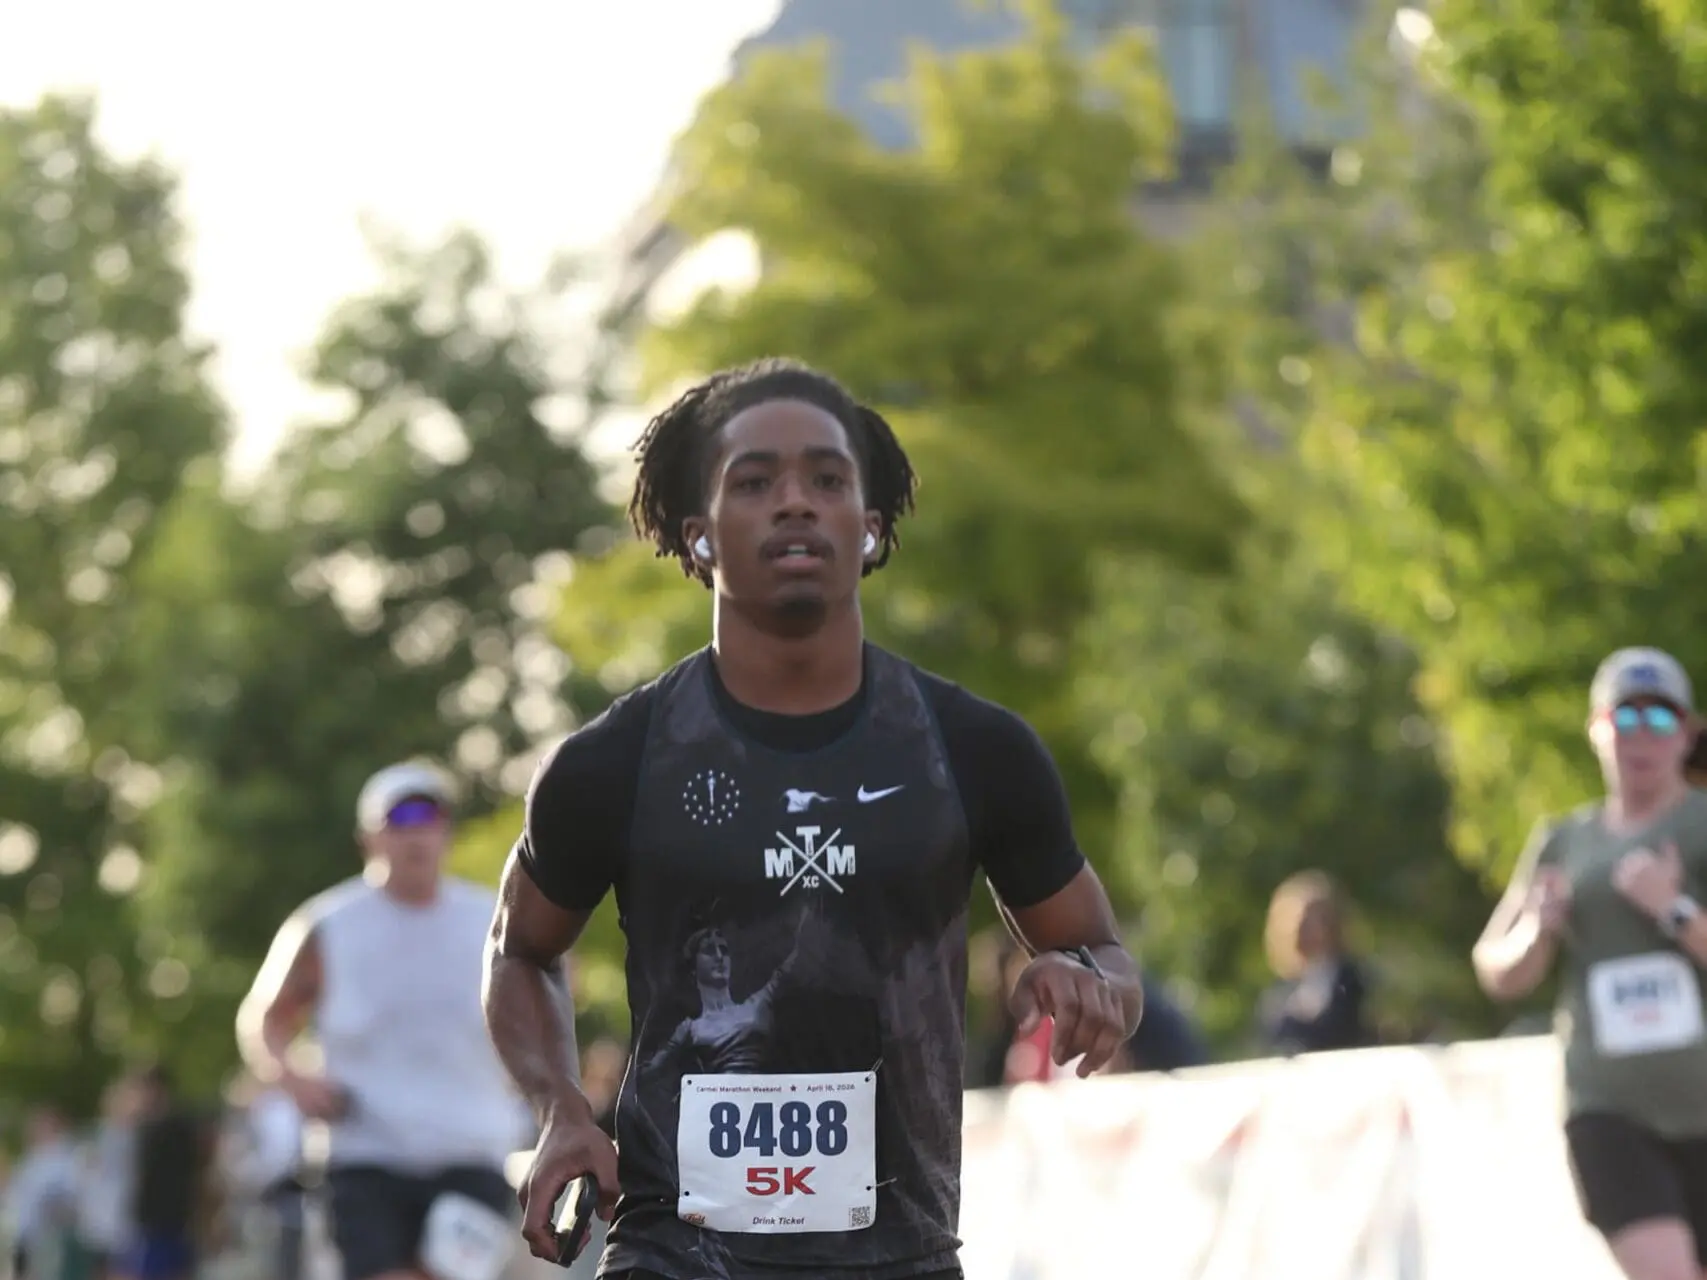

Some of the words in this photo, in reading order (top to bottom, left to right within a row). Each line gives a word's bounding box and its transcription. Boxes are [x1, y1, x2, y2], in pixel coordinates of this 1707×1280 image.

[802, 876, 820, 888] XC
[806, 1084, 823, 1093] April
[709, 1100, 848, 1158] 8488
[745, 1166, 816, 1196] 5K
[752, 1216, 776, 1225] Drink
[778, 1216, 805, 1225] Ticket
